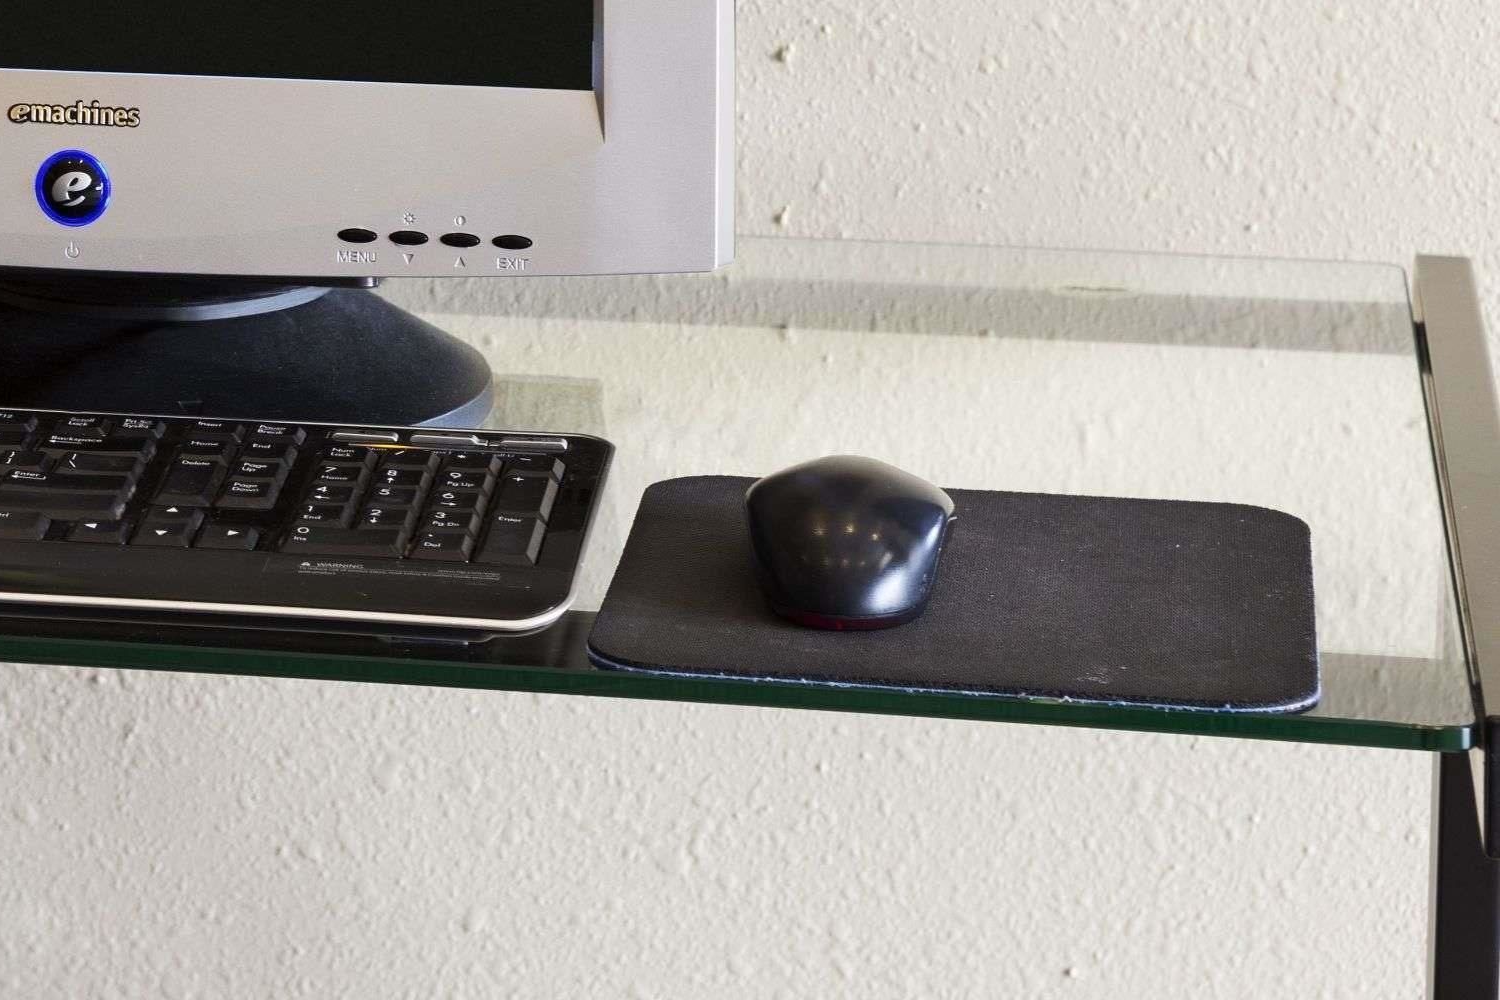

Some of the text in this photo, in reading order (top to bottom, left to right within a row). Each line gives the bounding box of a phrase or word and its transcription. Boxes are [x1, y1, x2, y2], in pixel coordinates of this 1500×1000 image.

[7, 100, 141, 128] emachines
[336, 250, 377, 263] MENU
[496, 258, 530, 270] EXIT
[370, 508, 382, 516] 2
